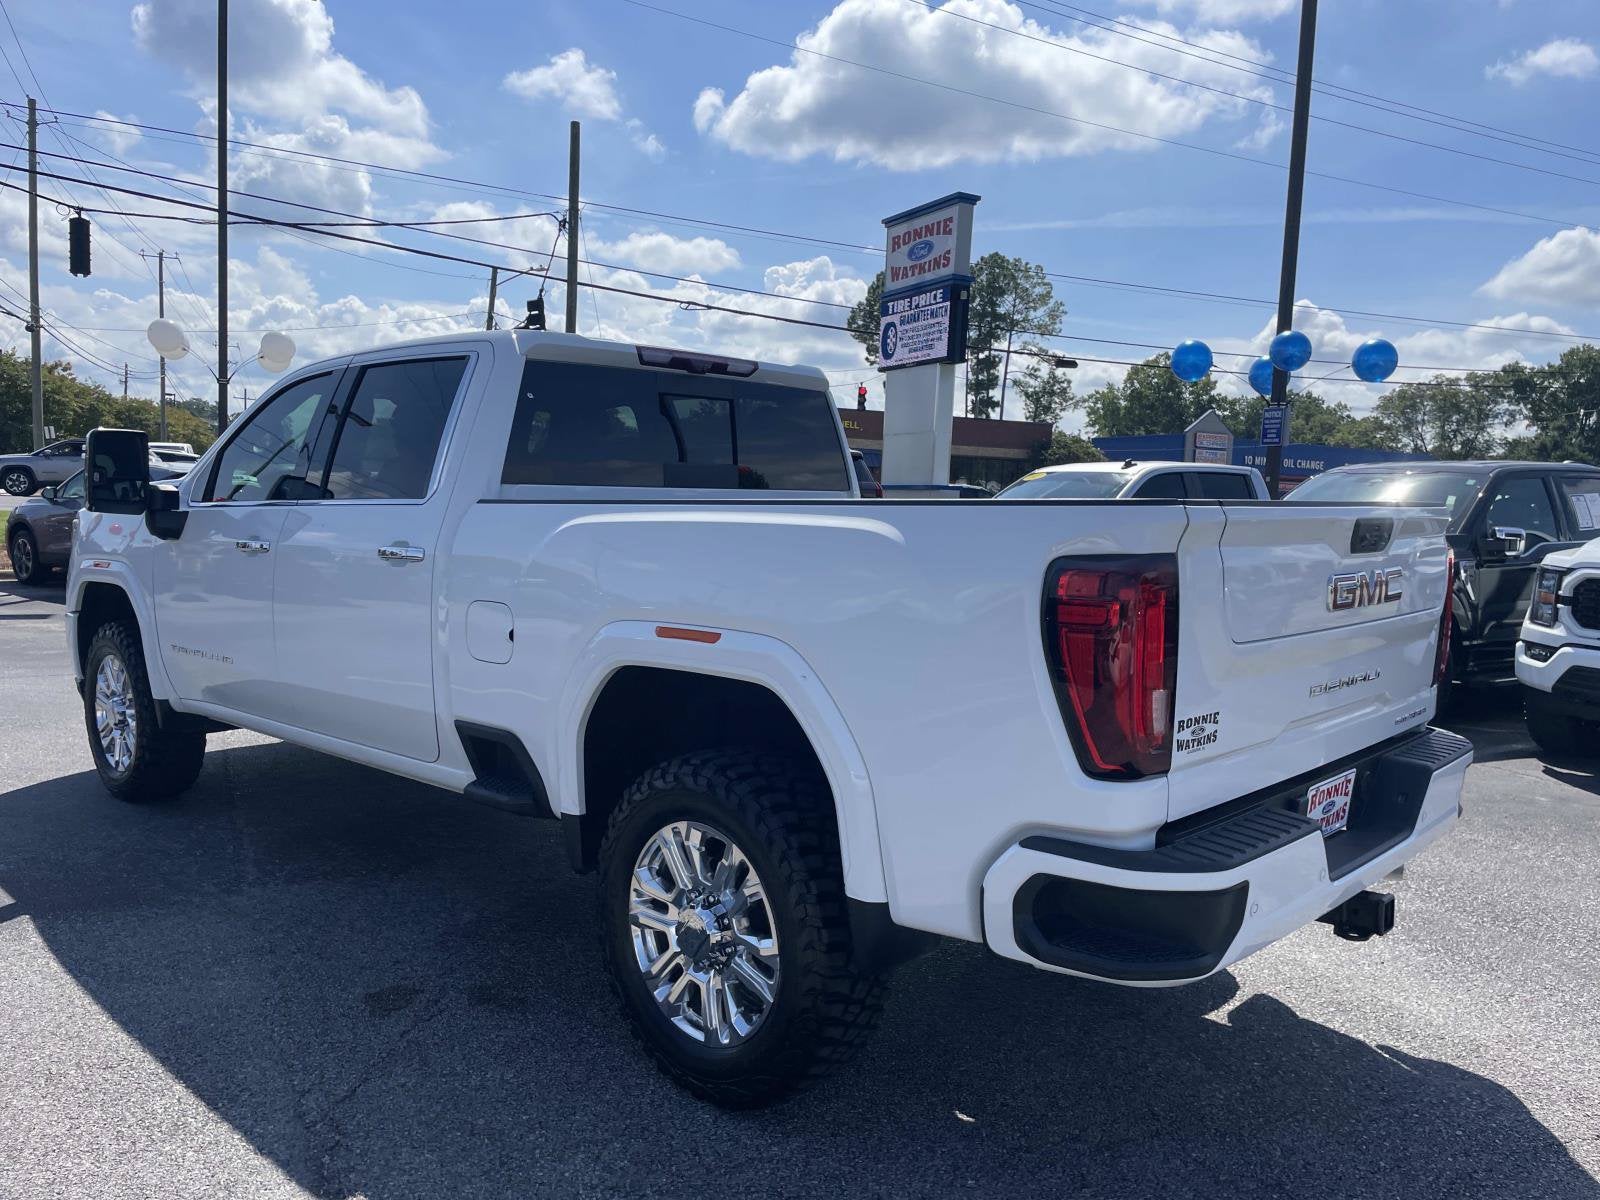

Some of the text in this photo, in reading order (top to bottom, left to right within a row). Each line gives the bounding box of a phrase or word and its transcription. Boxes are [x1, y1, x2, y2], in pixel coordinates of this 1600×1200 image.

[891, 216, 954, 253] RONNIE
[890, 249, 951, 282] WATKINS
[888, 289, 944, 315] TIRE PRICE
[900, 307, 930, 326] GUARANTEE
[1244, 455, 1253, 465] 10
[1283, 458, 1295, 468] OIL
[1296, 459, 1325, 471] CHANGE
[1326, 566, 1403, 612] GMC
[1177, 711, 1220, 734] RONNIE
[1176, 729, 1218, 753] WATKINS
[1308, 778, 1352, 814] RONNIE
